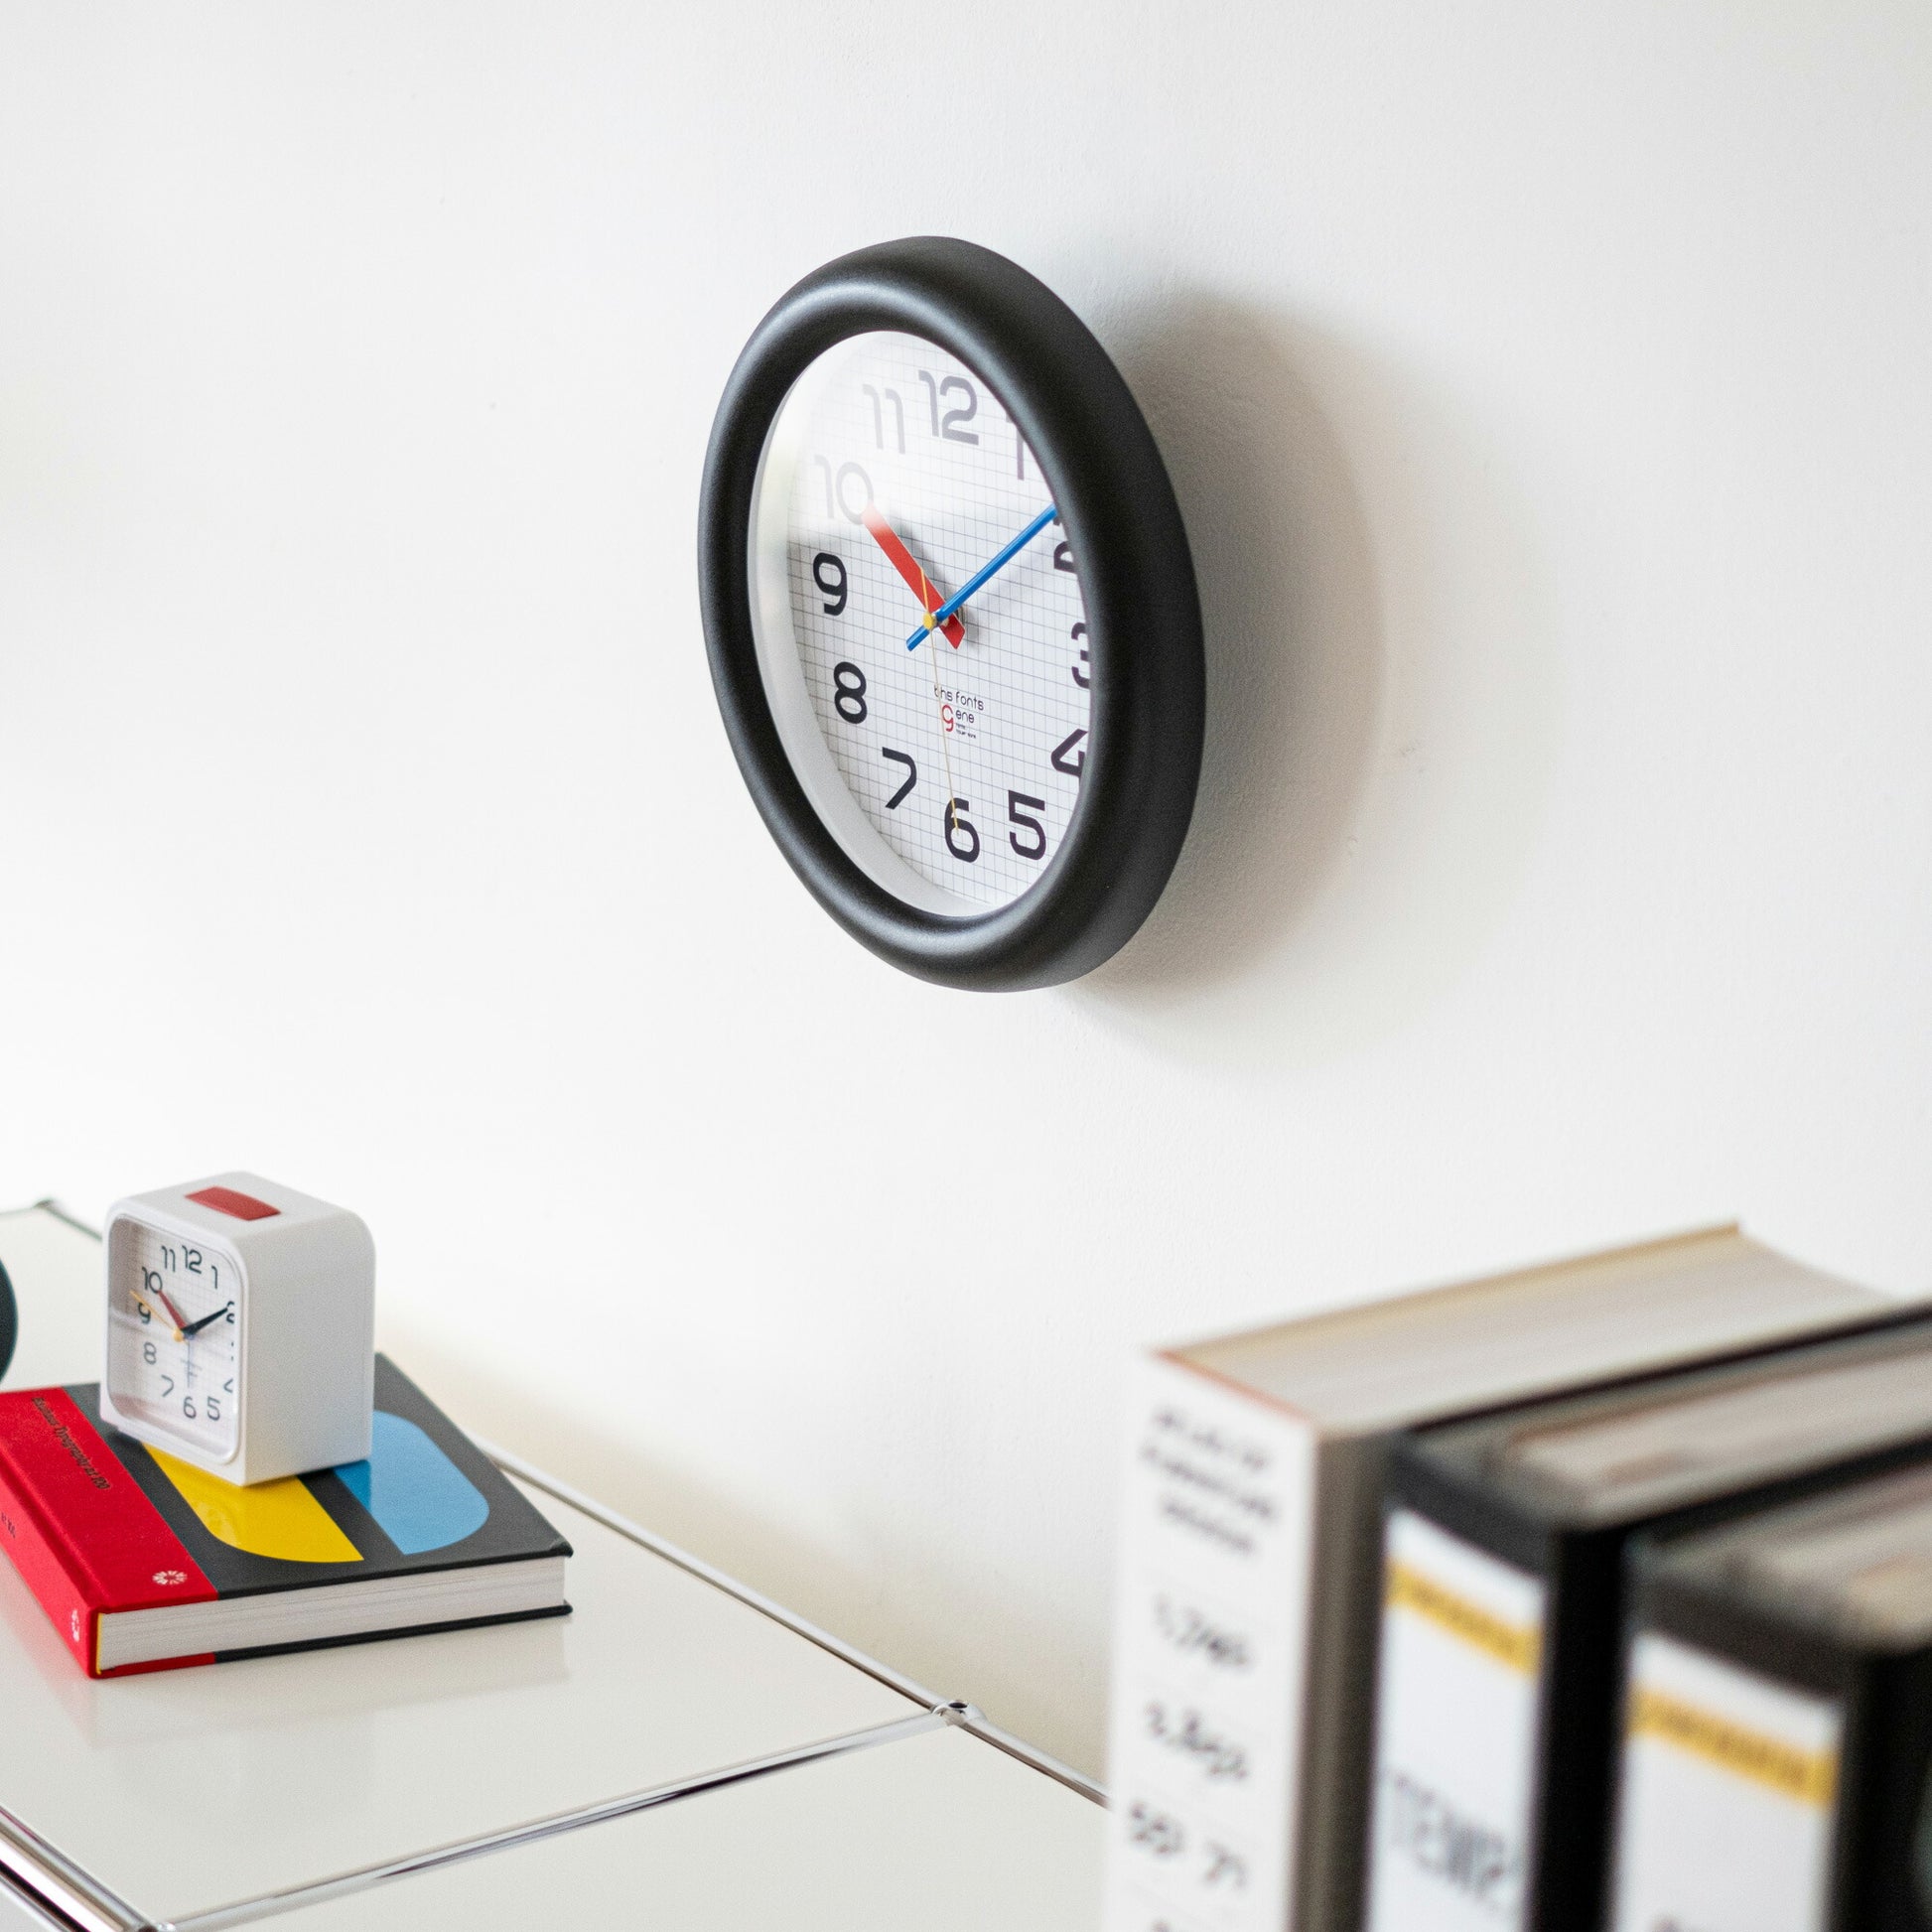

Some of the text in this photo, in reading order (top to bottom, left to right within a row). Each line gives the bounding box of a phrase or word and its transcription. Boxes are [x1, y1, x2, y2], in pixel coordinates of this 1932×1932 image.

[863, 383, 905, 454] 11
[918, 369, 979, 446] 12
[814, 454, 874, 525] 10
[812, 552, 848, 617] 9
[833, 661, 868, 724] 8
[956, 691, 984, 711] fonts
[1050, 729, 1088, 778] 4
[882, 747, 917, 810] 7
[944, 797, 980, 863] 6
[1008, 789, 1046, 861] 5
[161, 1245, 176, 1273] 11
[182, 1245, 203, 1275] 12
[211, 1265, 218, 1290] 1
[141, 1266, 163, 1295] 10
[143, 1342, 157, 1365] 8
[161, 1374, 175, 1398] 7
[183, 1396, 197, 1420] 6
[207, 1396, 220, 1422] 5
